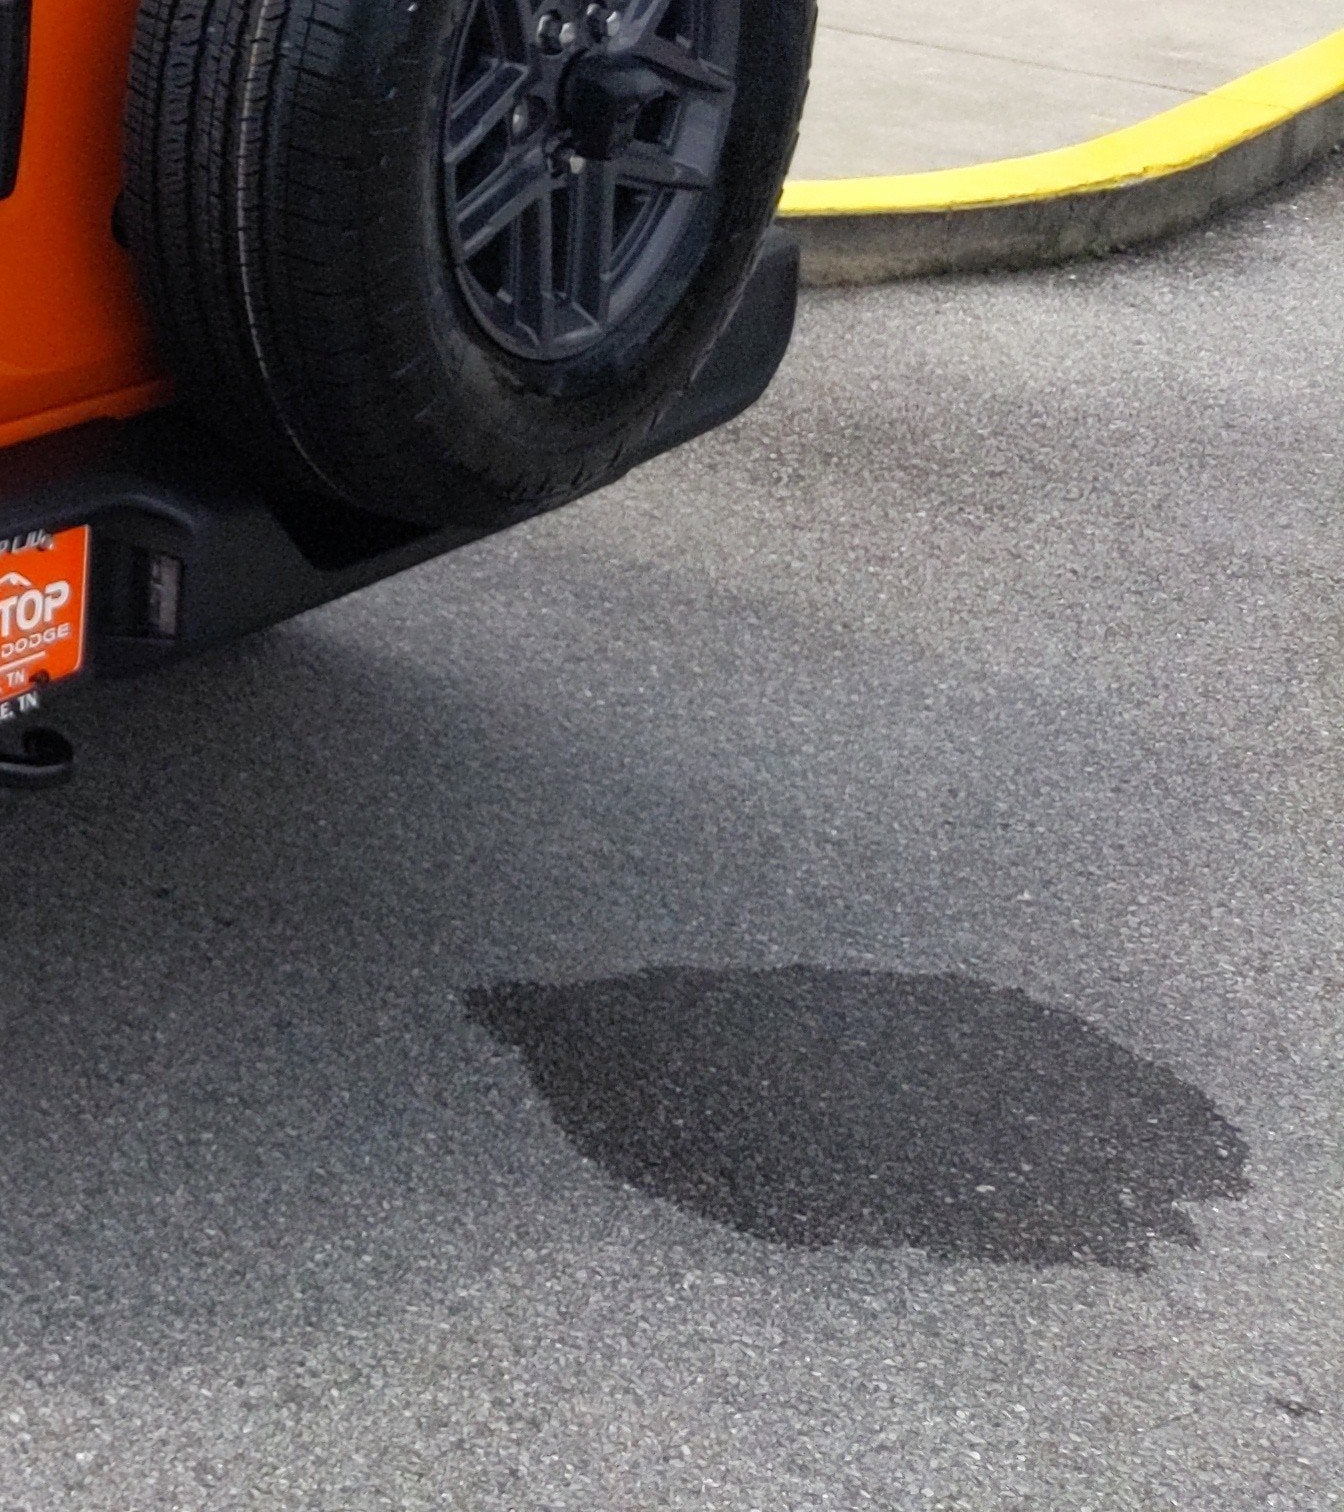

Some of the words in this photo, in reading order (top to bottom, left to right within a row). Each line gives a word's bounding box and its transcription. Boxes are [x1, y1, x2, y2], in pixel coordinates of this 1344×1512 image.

[1, 623, 71, 658] DODGE
[6, 670, 25, 688] TN
[17, 690, 39, 713] TN
